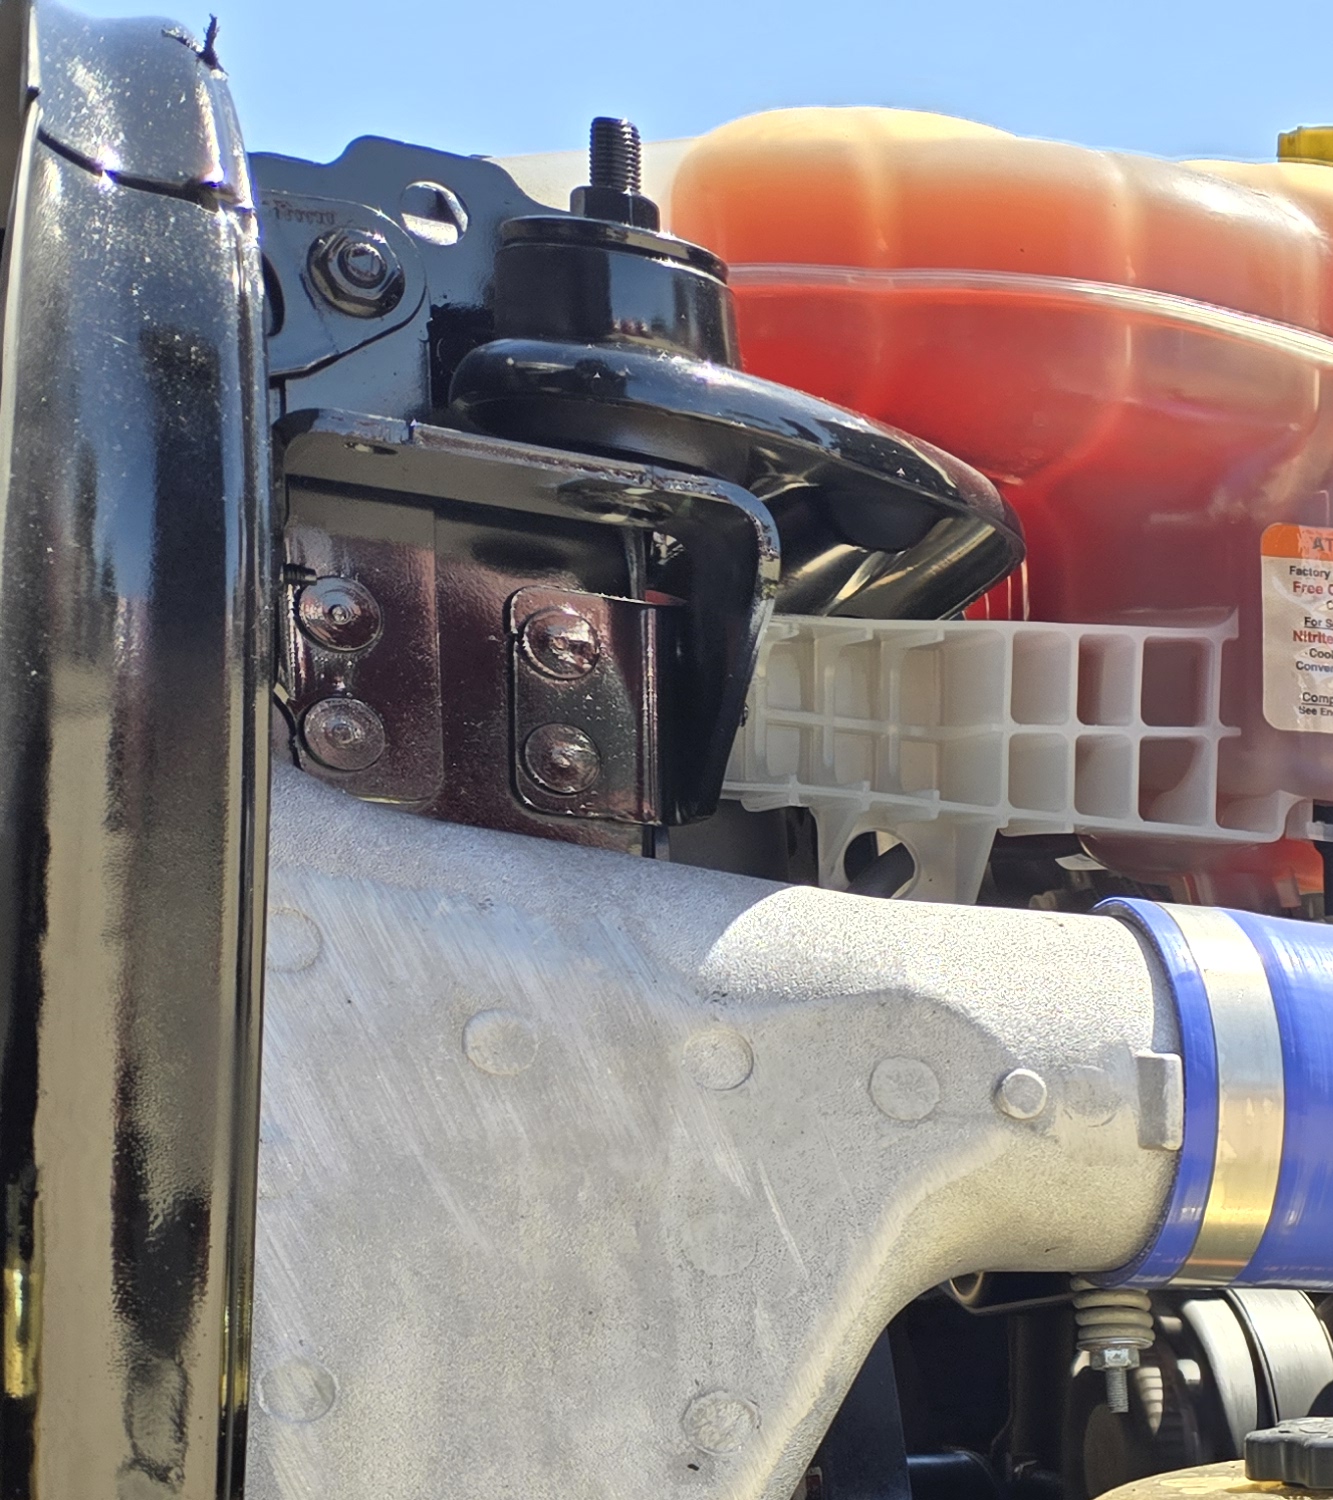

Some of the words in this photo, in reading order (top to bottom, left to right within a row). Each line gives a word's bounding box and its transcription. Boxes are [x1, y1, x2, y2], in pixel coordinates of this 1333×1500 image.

[1289, 565, 1331, 580] Factory
[1293, 581, 1323, 594] Free
[1304, 617, 1322, 627] For
